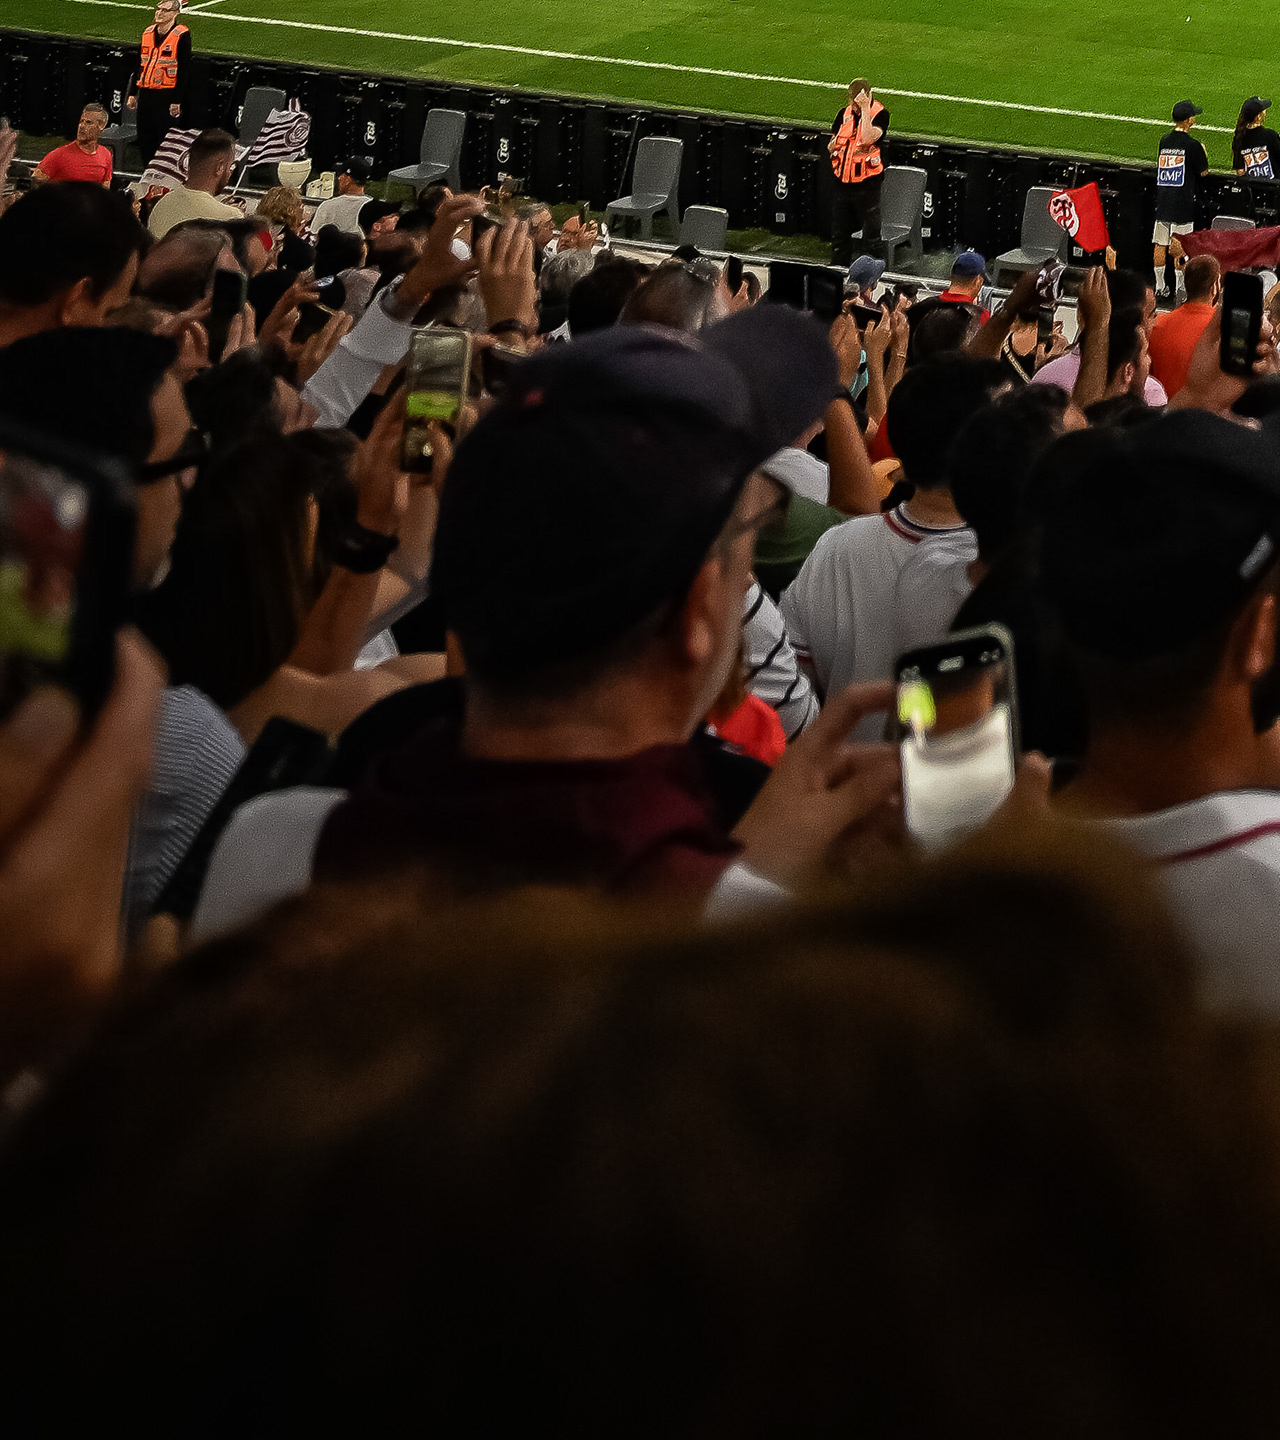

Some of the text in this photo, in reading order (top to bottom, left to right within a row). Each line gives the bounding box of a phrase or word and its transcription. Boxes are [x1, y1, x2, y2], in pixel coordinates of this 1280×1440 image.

[367, 120, 376, 142] TGI
[500, 138, 510, 160] TGI
[778, 172, 788, 194] TGI
